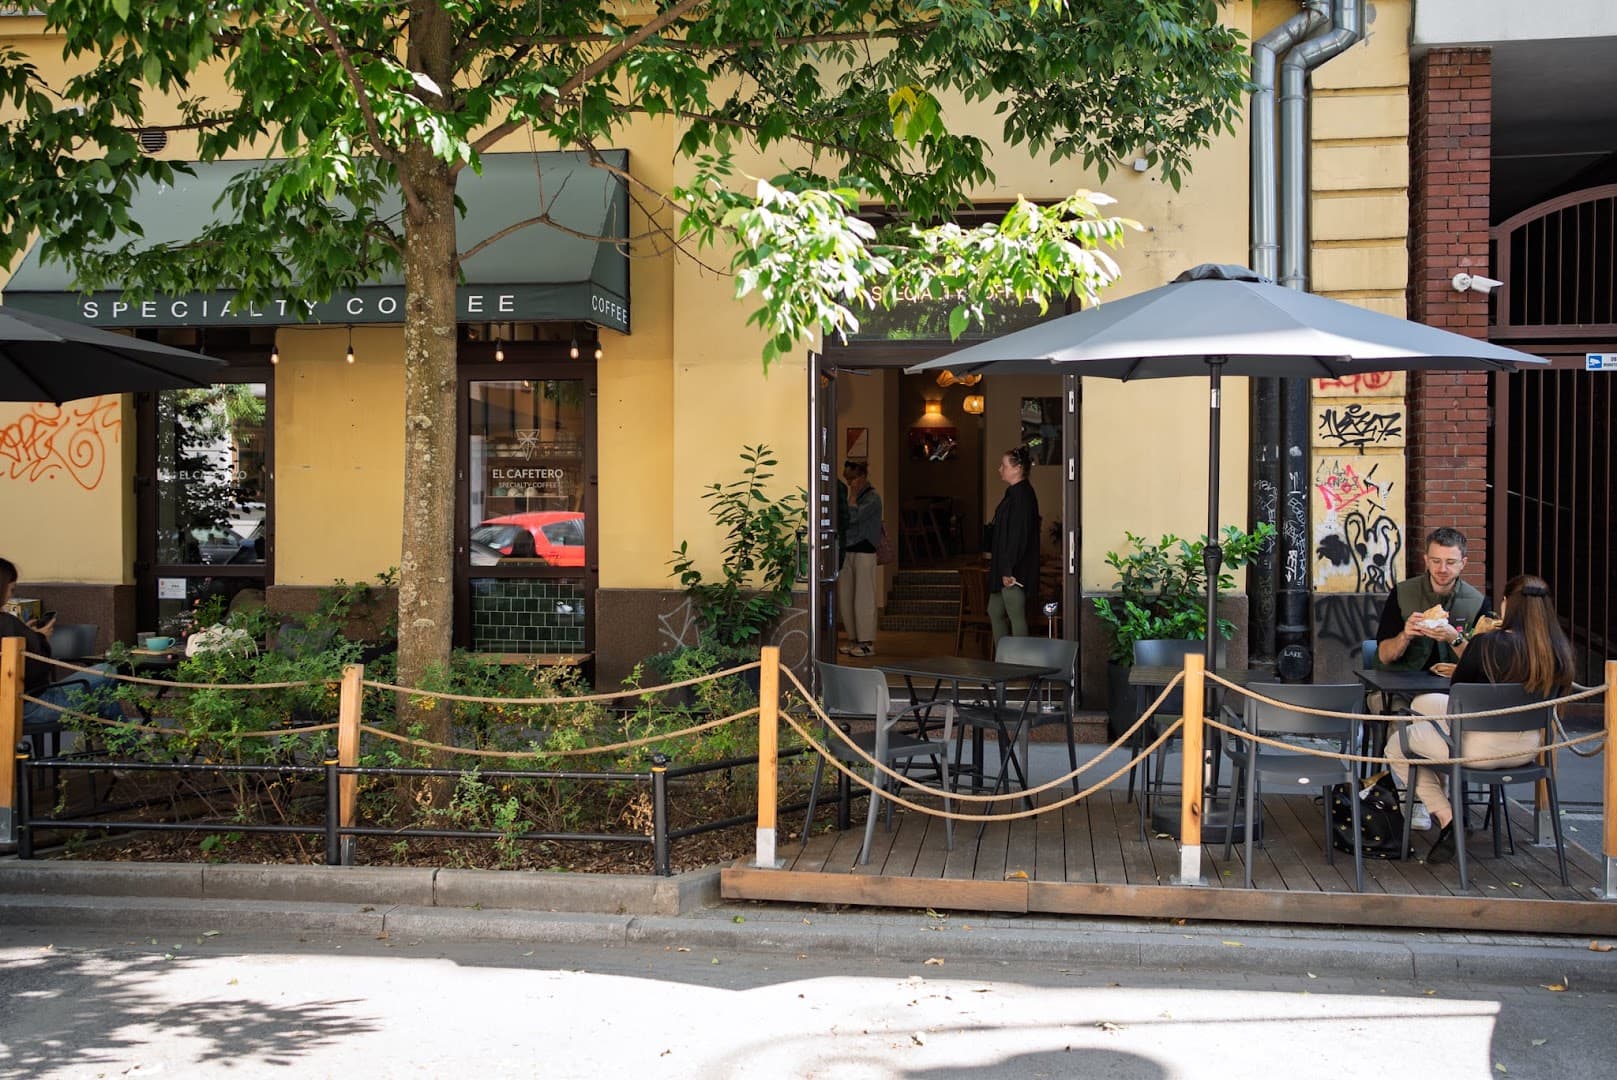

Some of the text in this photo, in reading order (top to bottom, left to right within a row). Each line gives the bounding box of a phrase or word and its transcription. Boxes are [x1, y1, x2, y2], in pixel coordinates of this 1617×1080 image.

[346, 295, 515, 315] COEE
[591, 295, 628, 325] COFFEE
[492, 468, 564, 479] EL CAFETERO
[499, 481, 557, 489] SPECIALTY COFFEE
